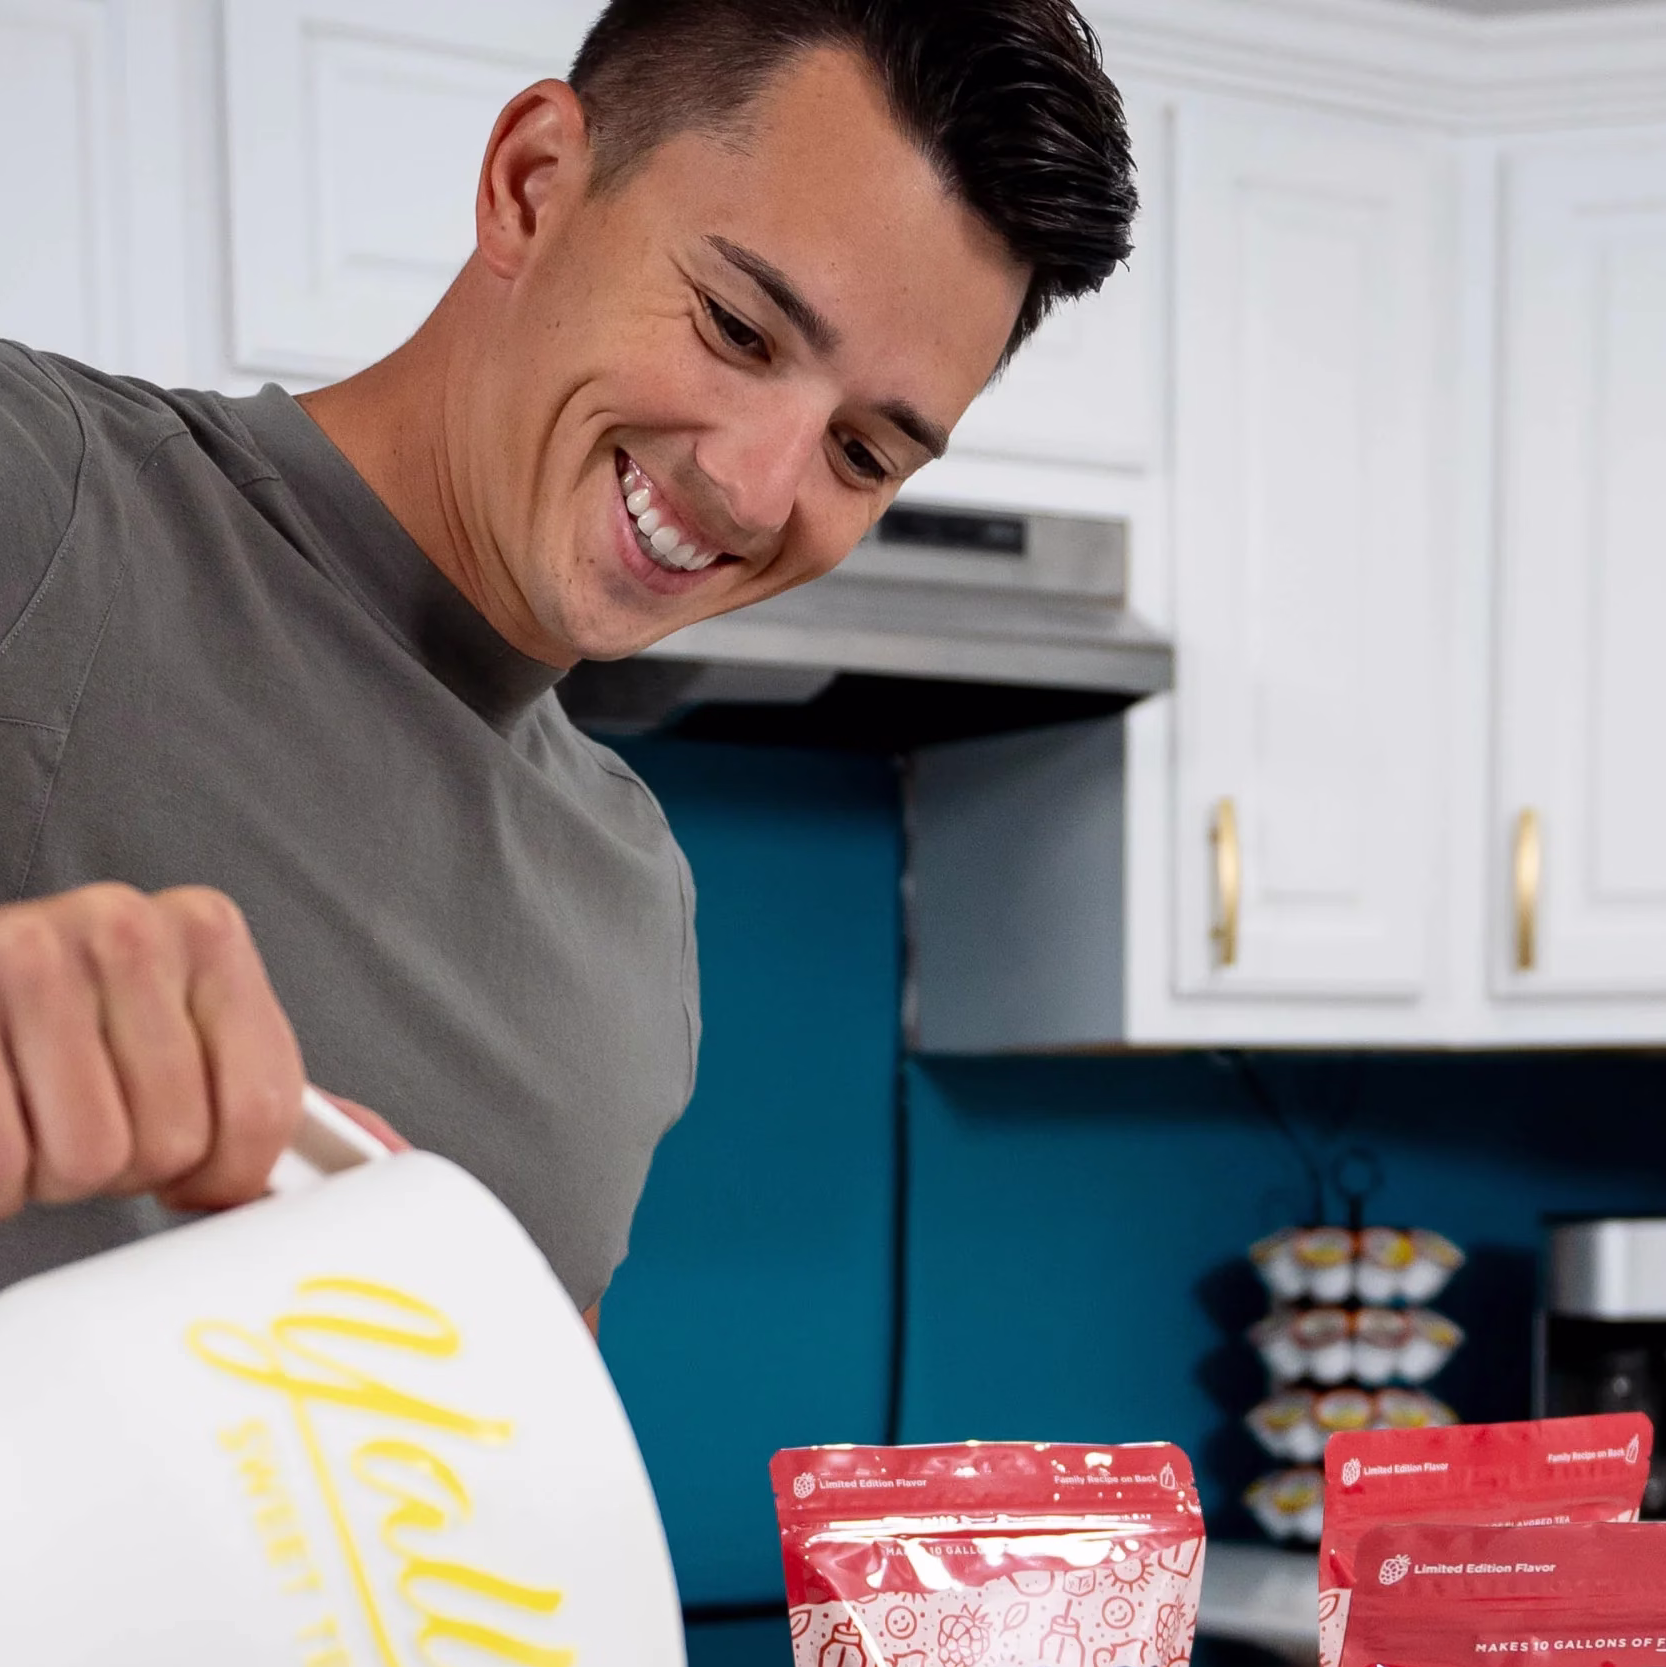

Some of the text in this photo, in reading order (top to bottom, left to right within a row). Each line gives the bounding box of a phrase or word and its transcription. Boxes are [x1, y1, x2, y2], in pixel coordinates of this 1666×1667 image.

[1547, 1452, 1571, 1463] Family
[1597, 1450, 1607, 1458] on
[1607, 1448, 1626, 1457] Back
[1363, 1462, 1449, 1476] Limited Edition Flavor
[819, 1478, 928, 1490] Limited Edition Flavor
[1054, 1475, 1085, 1485] Family
[1086, 1475, 1119, 1485] Recipe
[1134, 1474, 1158, 1483] Back
[216, 1417, 323, 1596] SWEET
[1554, 1515, 1570, 1525] TEA
[1414, 1562, 1556, 1575] Limited Edition Flavor
[1475, 1642, 1528, 1653] MAKES
[1533, 1640, 1549, 1651] 10
[1553, 1637, 1626, 1650] GALLONS
[1631, 1637, 1652, 1648] OF
